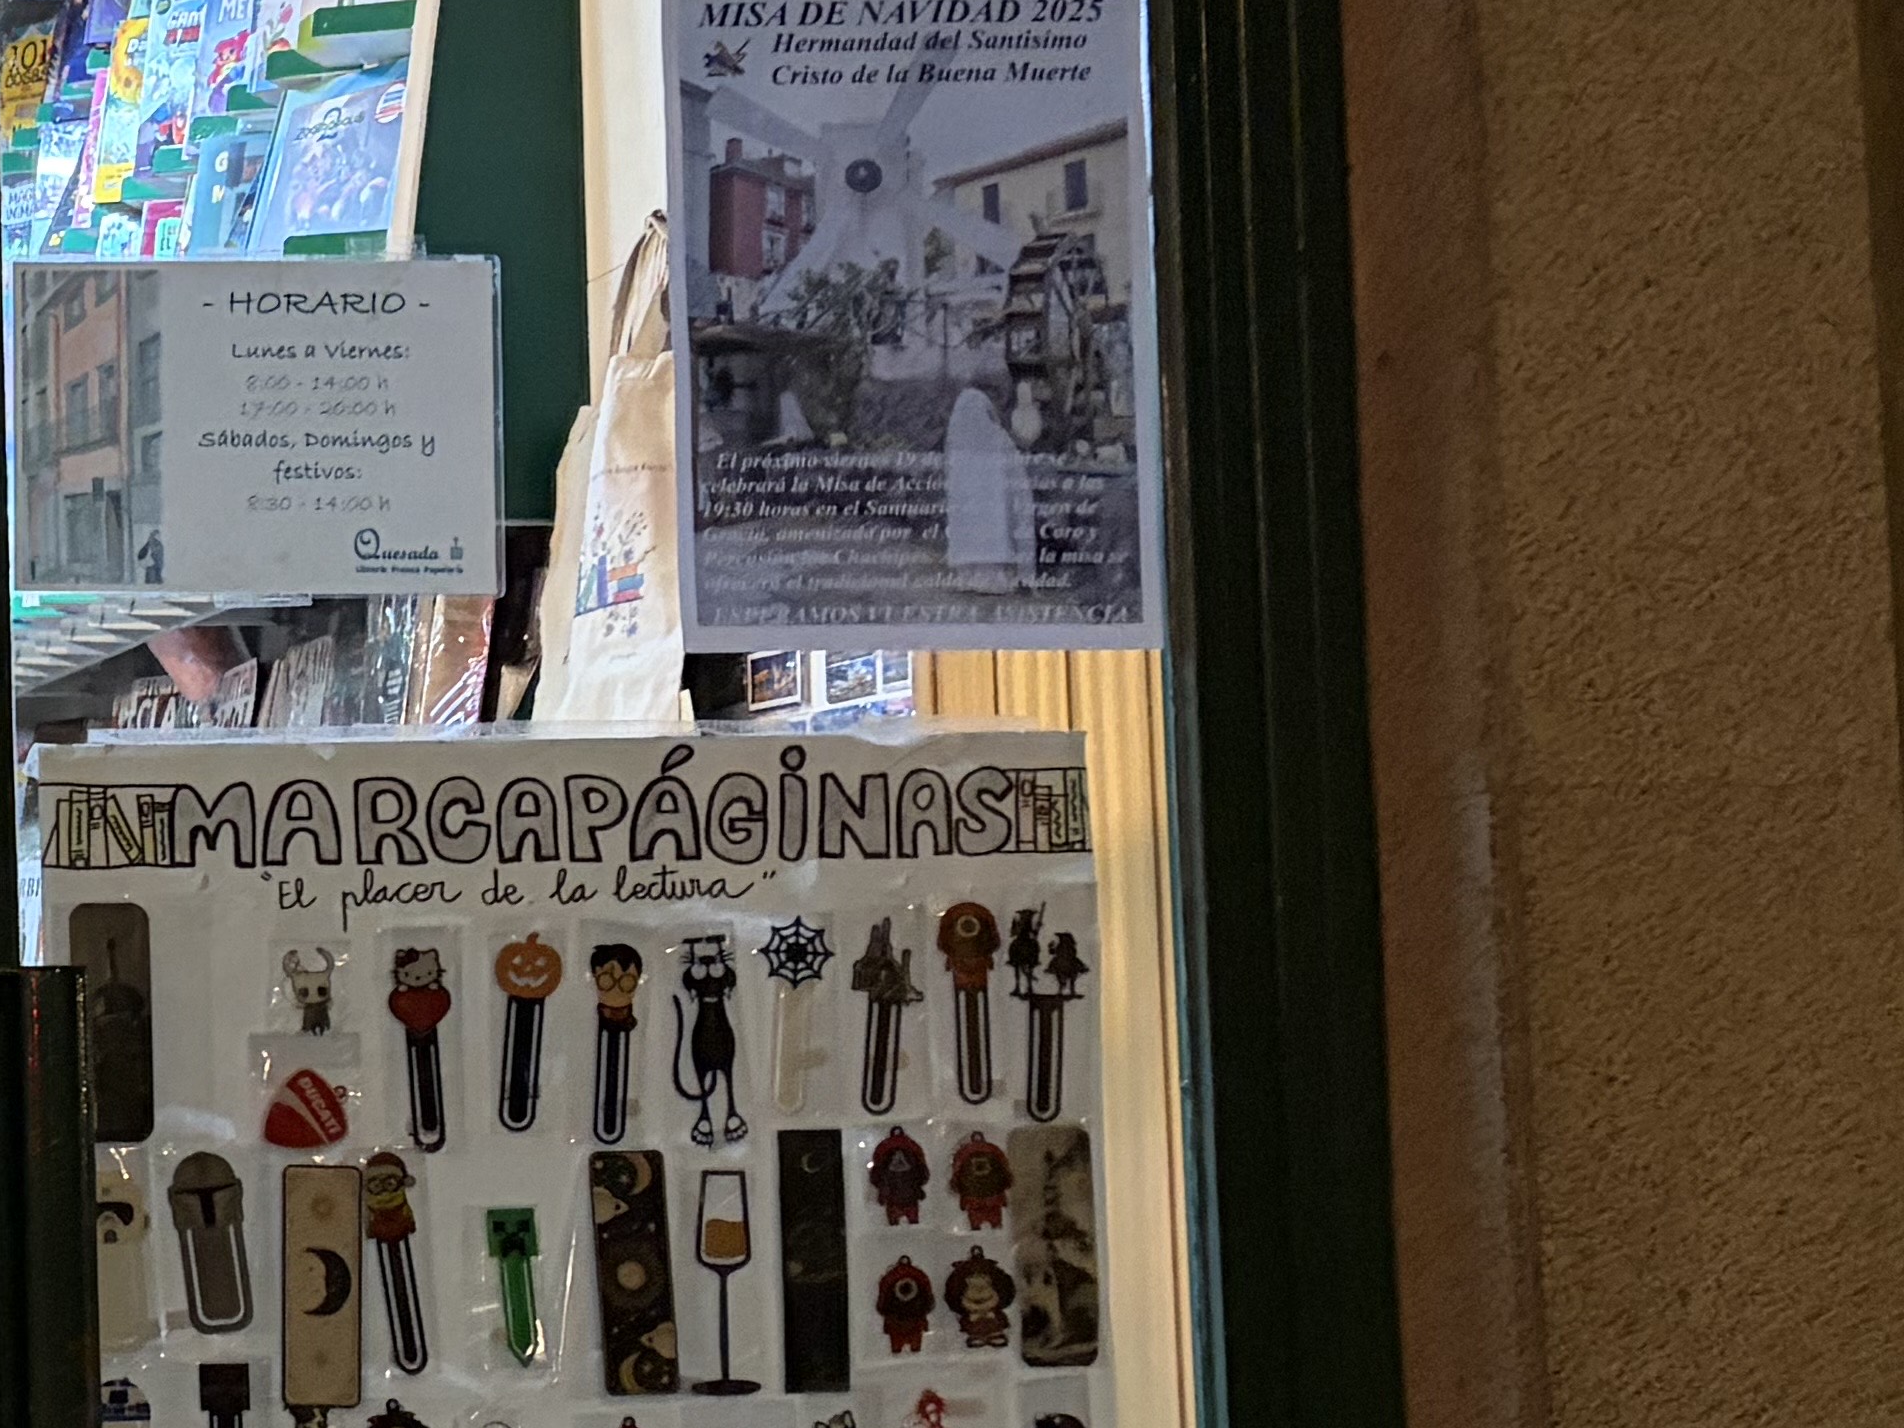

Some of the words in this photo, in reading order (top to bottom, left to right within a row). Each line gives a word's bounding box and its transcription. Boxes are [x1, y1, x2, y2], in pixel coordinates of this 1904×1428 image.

[699, 1, 789, 29] MISA
[797, 1, 849, 27] DE
[857, 0, 1022, 27] NAVIDAD
[772, 31, 916, 54] Hermandad
[925, 29, 961, 52] del
[773, 63, 843, 86] Cristo
[852, 63, 879, 85] de
[886, 63, 908, 84] la
[918, 63, 997, 84] Buena
[1005, 62, 1091, 83] Muerte
[229, 292, 406, 316] HORARIO
[231, 342, 297, 360] Lunes
[304, 347, 319, 359] a
[325, 341, 410, 360] Viernes:
[199, 430, 296, 452] Sábados,
[304, 431, 413, 453] Domingos
[420, 434, 436, 455] y
[273, 460, 361, 482] festivos:
[354, 528, 438, 564] Quesada
[341, 873, 460, 931] placer
[481, 868, 526, 906] de
[551, 868, 598, 906] la
[295, 1075, 341, 1139] DUCATI
